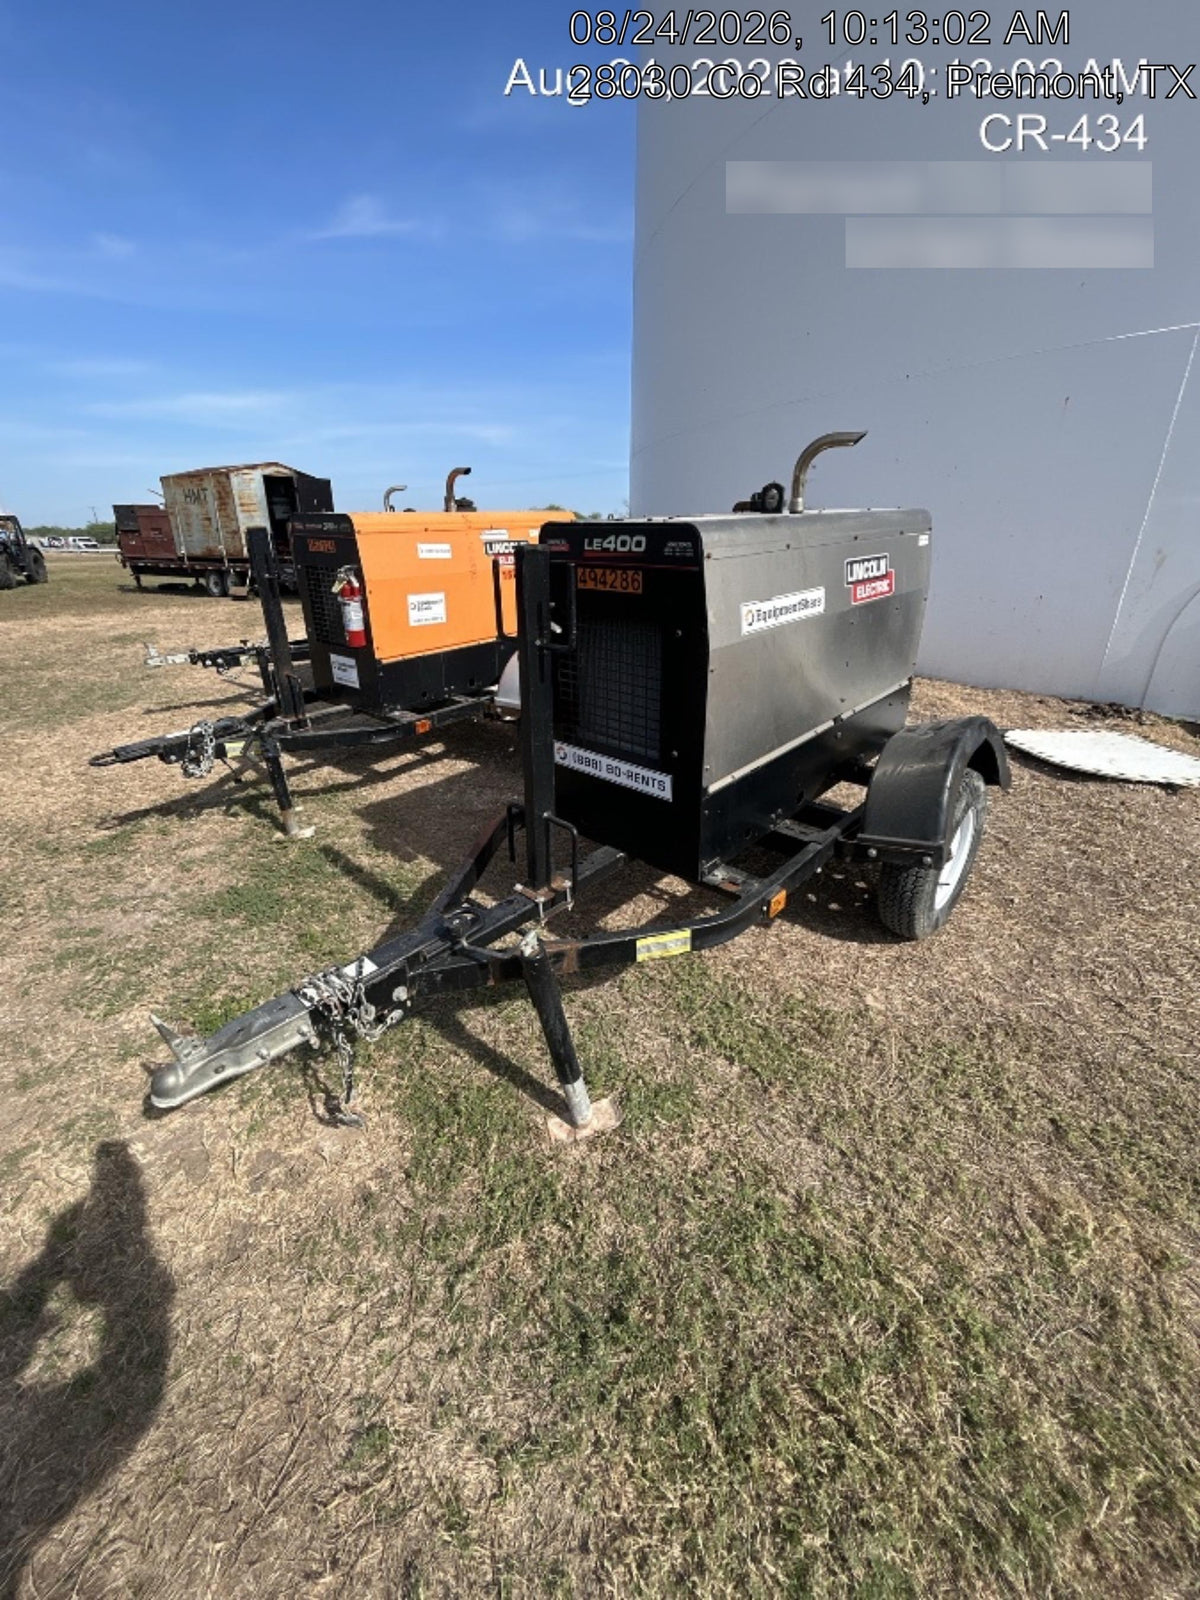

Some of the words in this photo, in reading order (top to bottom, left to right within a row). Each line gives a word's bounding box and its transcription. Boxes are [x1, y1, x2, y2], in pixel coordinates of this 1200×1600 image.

[584, 534, 646, 552] LE400
[578, 566, 641, 592] 494286
[847, 557, 887, 583] LINCOLN
[856, 579, 891, 600] ELECTRIC
